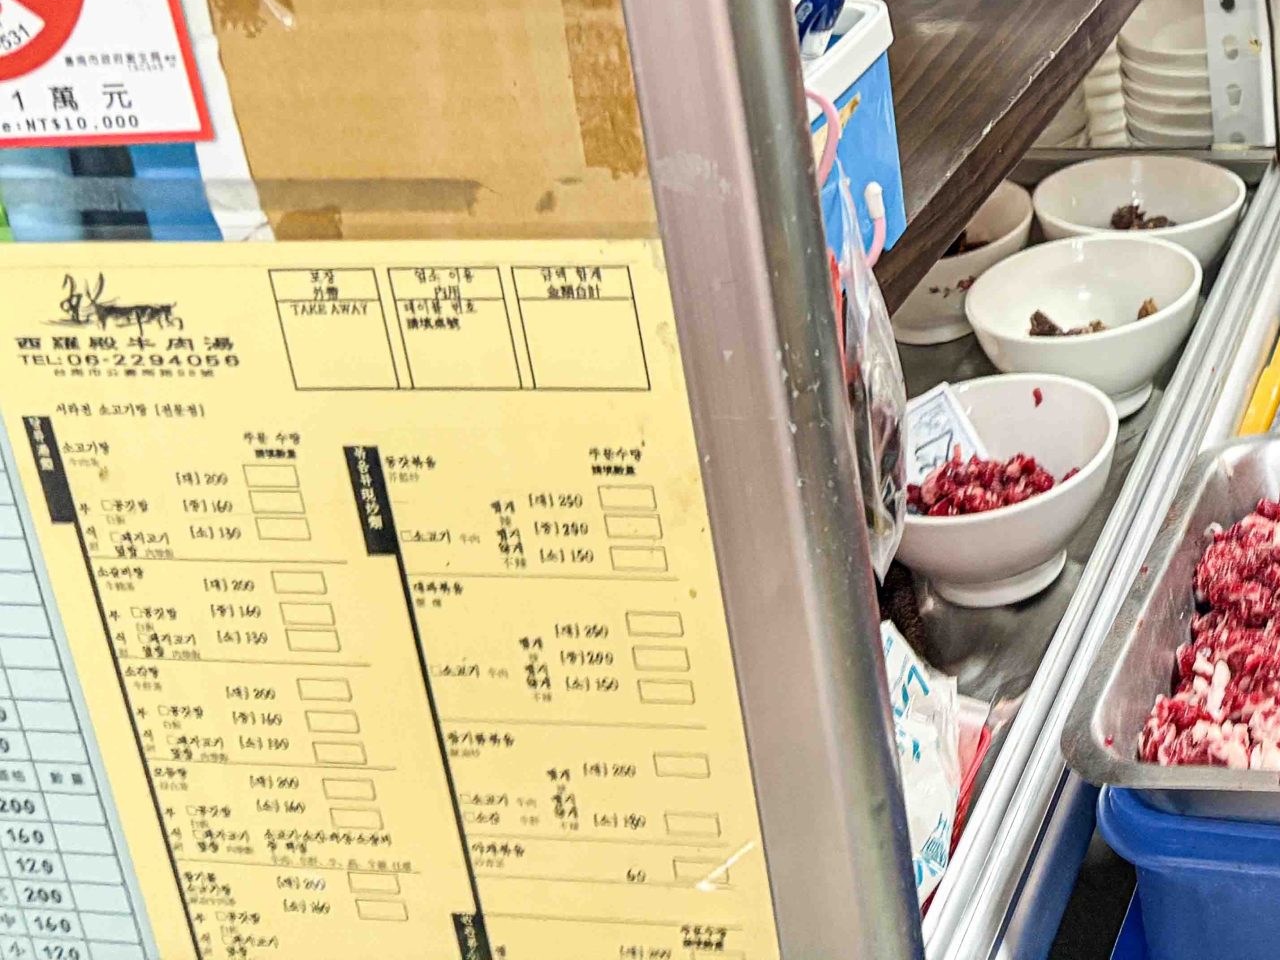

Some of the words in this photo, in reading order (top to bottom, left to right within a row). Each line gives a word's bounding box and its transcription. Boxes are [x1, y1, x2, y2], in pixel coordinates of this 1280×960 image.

[290, 304, 327, 316] TAKE
[331, 303, 369, 316] AWAY
[15, 335, 234, 351] 西羅殿牛肉湯
[204, 472, 229, 486] 200
[0, 798, 36, 815] 200
[6, 827, 45, 845] 160
[16, 857, 54, 875] 120
[24, 887, 62, 904] 200
[34, 915, 72, 933] 160
[43, 945, 80, 960] 120
